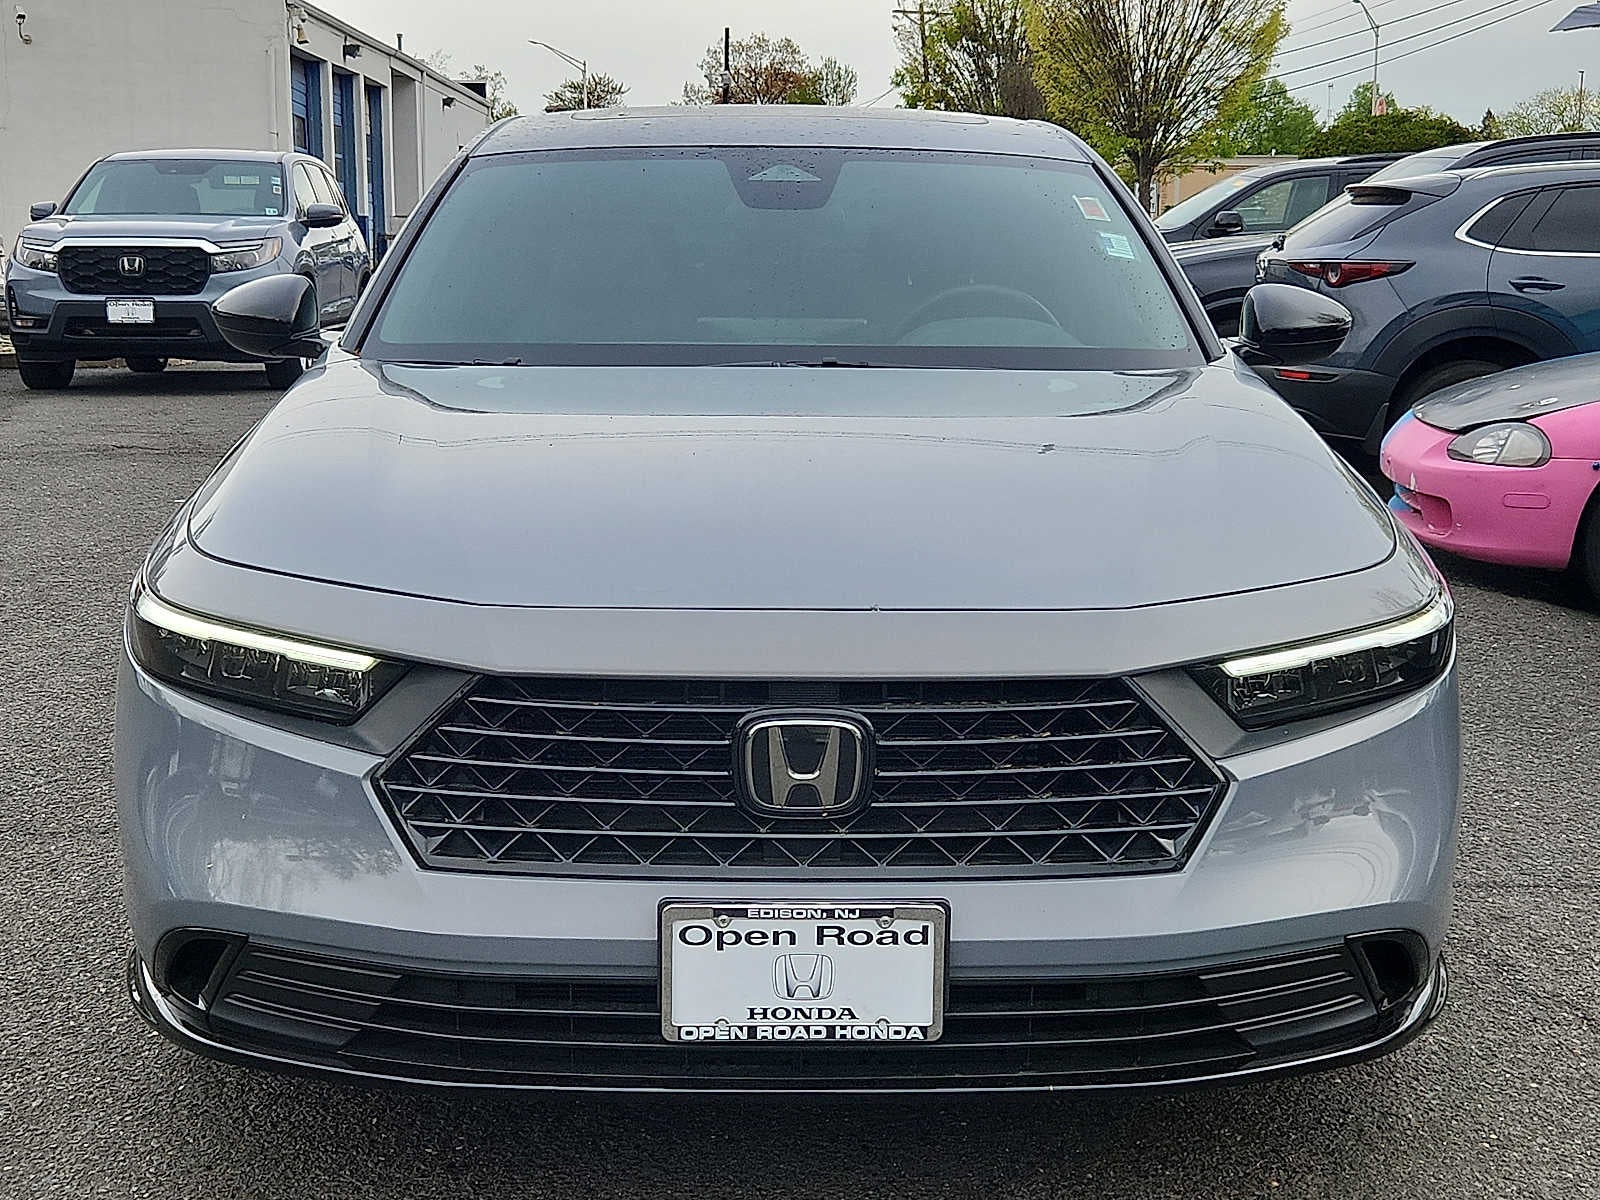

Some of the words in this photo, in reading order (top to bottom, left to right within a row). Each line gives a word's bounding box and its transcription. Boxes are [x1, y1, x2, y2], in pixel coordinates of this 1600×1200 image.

[747, 908, 827, 919] EDISON,
[834, 908, 860, 919] NJ
[678, 925, 797, 951] Open
[816, 925, 929, 946] Road
[746, 1007, 860, 1020] HONDA
[680, 1026, 748, 1040] OPEN
[756, 1025, 827, 1040] ROAD
[835, 1025, 924, 1040] HONDA
